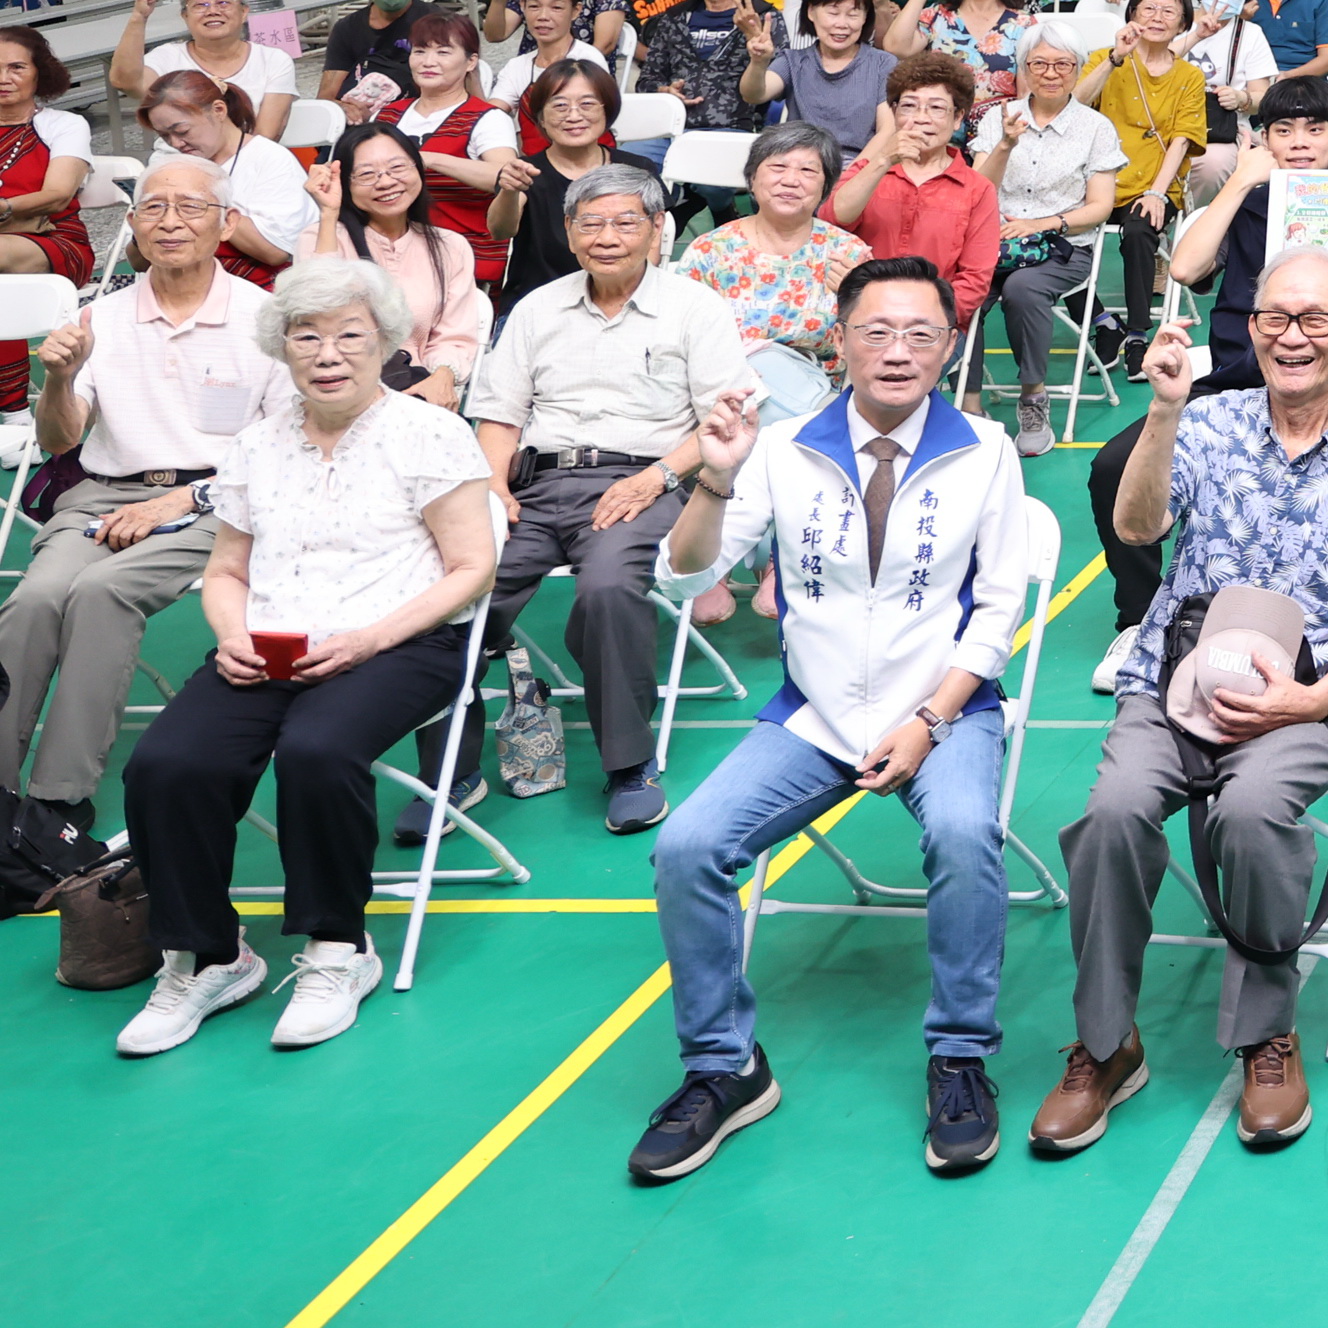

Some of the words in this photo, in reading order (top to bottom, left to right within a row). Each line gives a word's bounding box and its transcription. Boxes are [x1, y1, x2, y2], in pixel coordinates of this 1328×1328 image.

[903, 488, 939, 612] 南投縣政府
